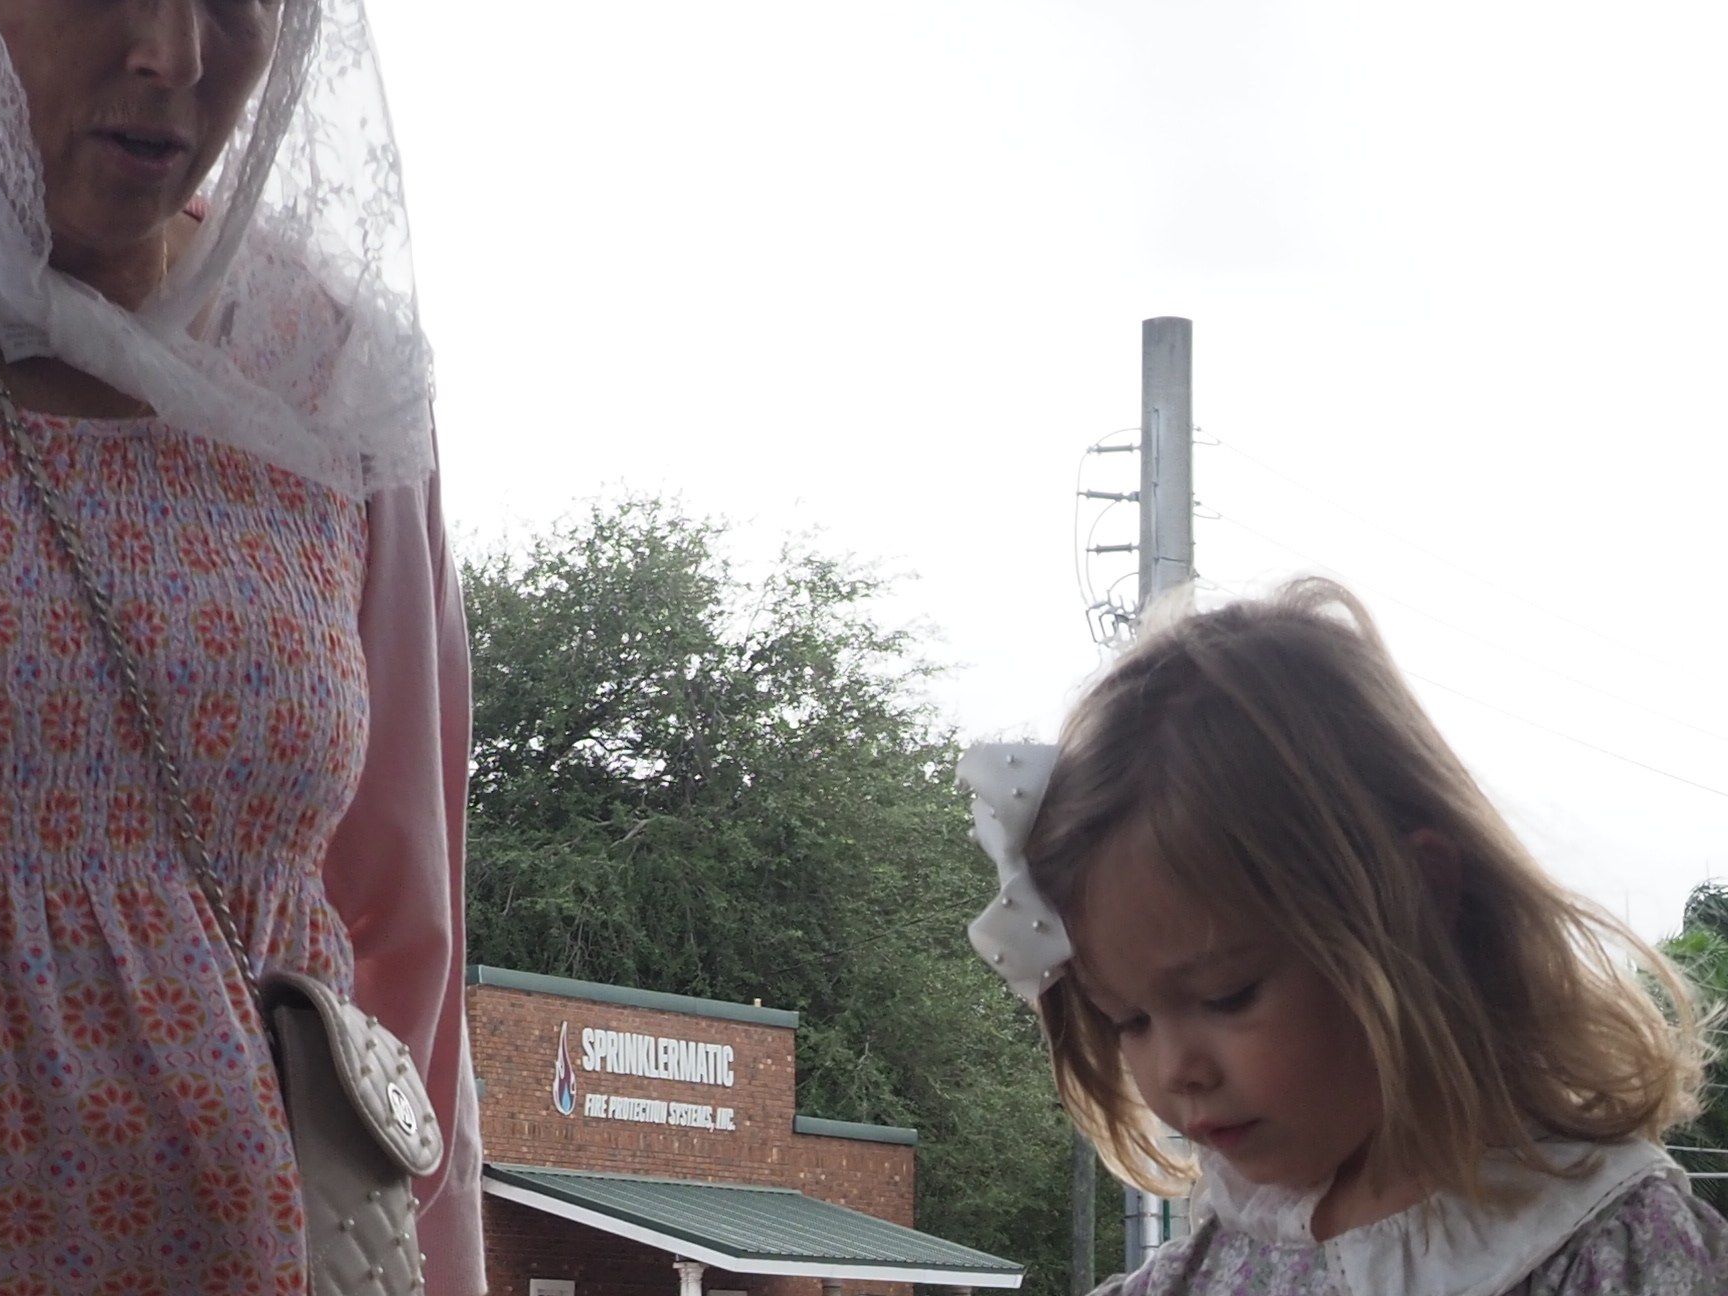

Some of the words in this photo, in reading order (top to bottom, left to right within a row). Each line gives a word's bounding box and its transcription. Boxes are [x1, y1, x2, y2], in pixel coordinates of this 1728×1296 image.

[582, 1028, 735, 1087] SPRINKLERMATIC
[584, 1094, 608, 1117] FIRE
[608, 1096, 668, 1123] PROTECTION
[668, 1102, 714, 1132] SYSTEMS,
[715, 1107, 736, 1131] INC.
